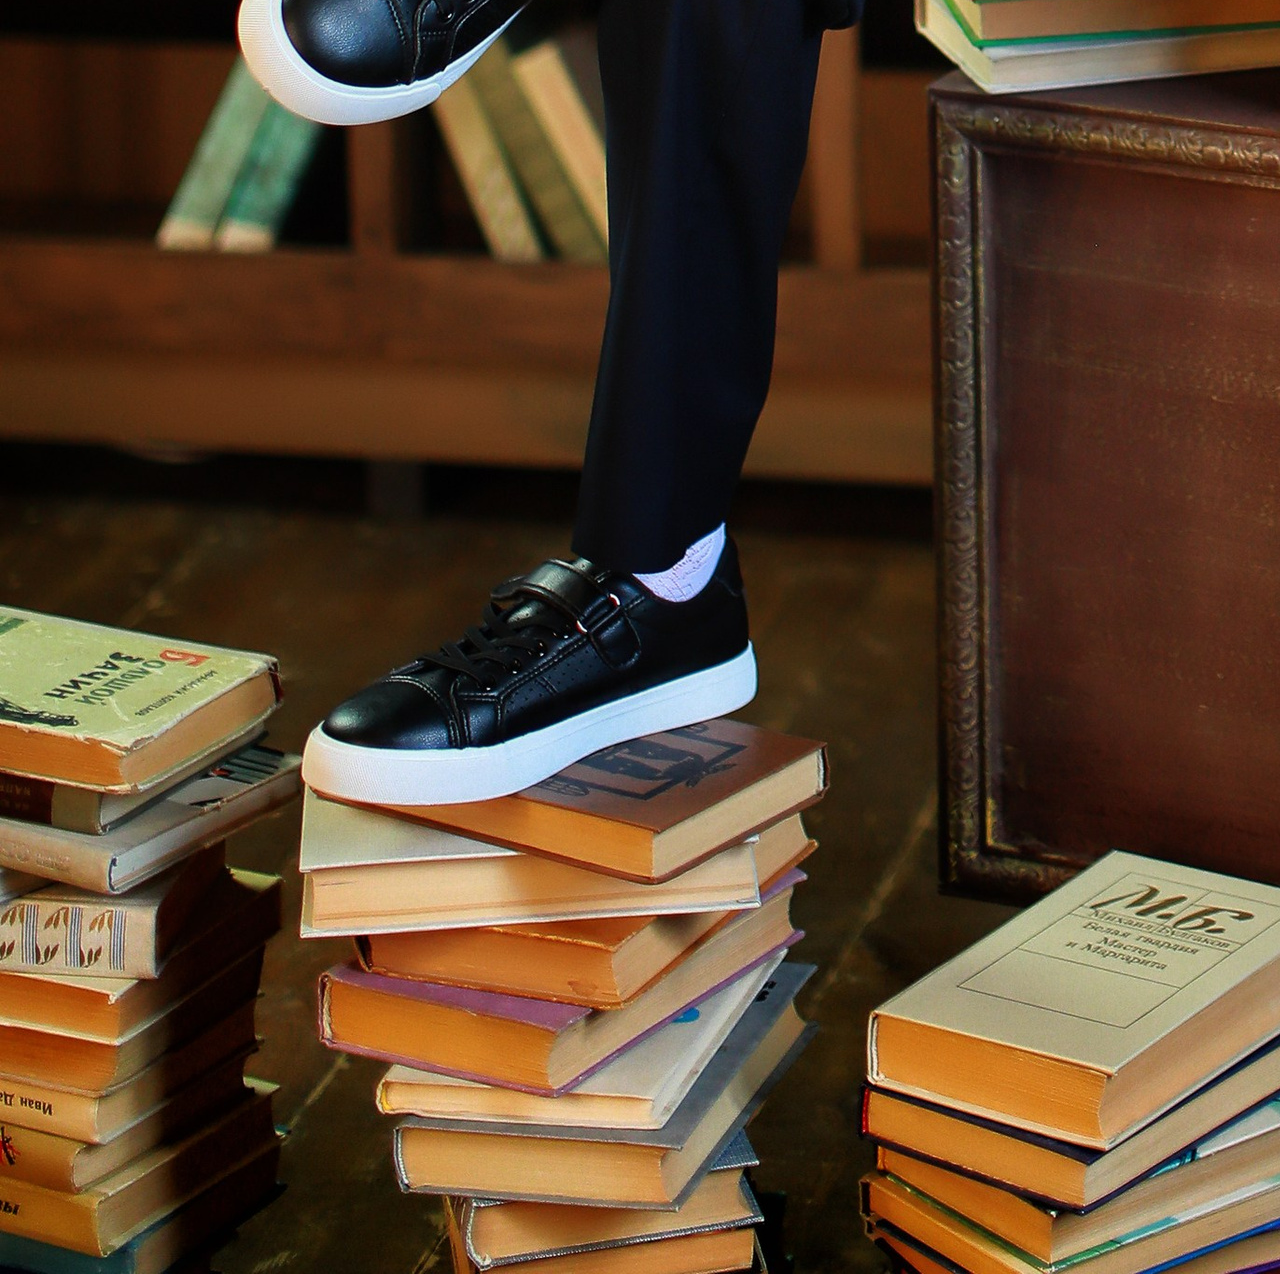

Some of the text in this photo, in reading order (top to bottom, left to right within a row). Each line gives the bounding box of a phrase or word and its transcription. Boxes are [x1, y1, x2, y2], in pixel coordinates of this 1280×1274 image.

[43, 651, 145, 700] ЗАЧИН
[74, 648, 211, 707] БОЛЬШОЙ
[1082, 920, 1200, 955] Белая гвардия
[1088, 909, 1232, 949] Михаил Булгаков
[1098, 935, 1158, 958] Мастер
[1065, 940, 1169, 971] и Маргарита
[20, 1095, 53, 1116] Иван
